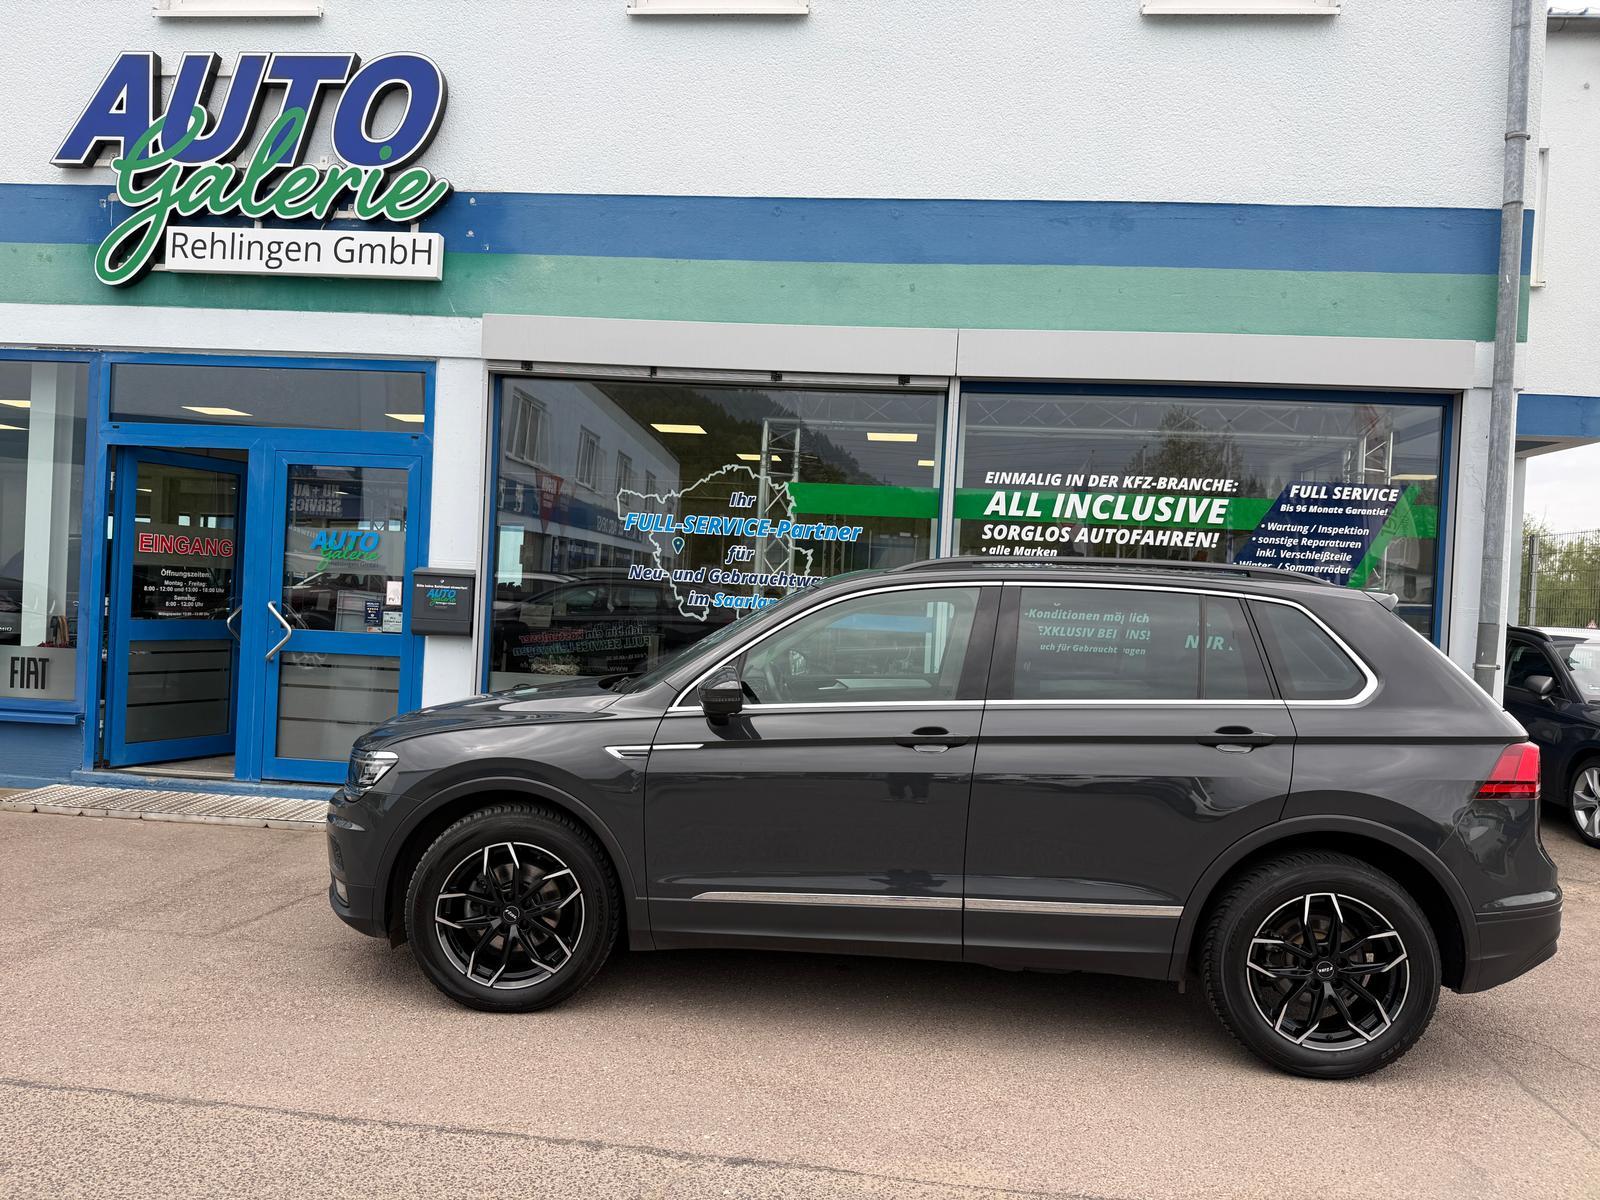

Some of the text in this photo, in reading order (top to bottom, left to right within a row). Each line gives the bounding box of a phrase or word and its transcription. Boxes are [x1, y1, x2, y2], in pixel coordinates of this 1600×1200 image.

[50, 51, 446, 168] AUTO
[95, 104, 453, 286] Galerie
[171, 232, 433, 270] Rehlingen GmbH
[985, 471, 1239, 493] EINMALIG IN DER KFZ-BRANCHE:
[729, 491, 757, 508] Ihr
[1289, 484, 1399, 502] FULL SERVICE
[984, 491, 1229, 525] ALL INCLUSIVE
[1280, 504, 1388, 517] Bis 96 Monate Garantie!
[624, 512, 864, 543] FULL-SERVICE-Partner
[1267, 523, 1309, 535] Wartung
[1318, 525, 1370, 538] Inspektion
[138, 532, 233, 556] EINGANG
[310, 530, 380, 552] AUTO
[982, 524, 1220, 549] SORGLOS AUTOFAHREN!
[1257, 536, 1362, 551] sonstige Reparaturen
[725, 546, 755, 564] für
[989, 547, 1058, 557] alle Marken
[1256, 548, 1352, 561] inkl. Verschleißteile
[160, 568, 211, 579] Öffnungszeiten:
[627, 565, 828, 588] Neu- und Gebrauchtwa
[1284, 563, 1352, 575] Sommerräder
[164, 580, 183, 588] Montag
[426, 589, 457, 599] AUTO
[687, 591, 711, 606] im
[1097, 628, 1118, 639] BEI
[1039, 643, 1055, 651] uch
[1072, 645, 1147, 656] Gebrauchtagen
[10, 657, 49, 689] FIAT
